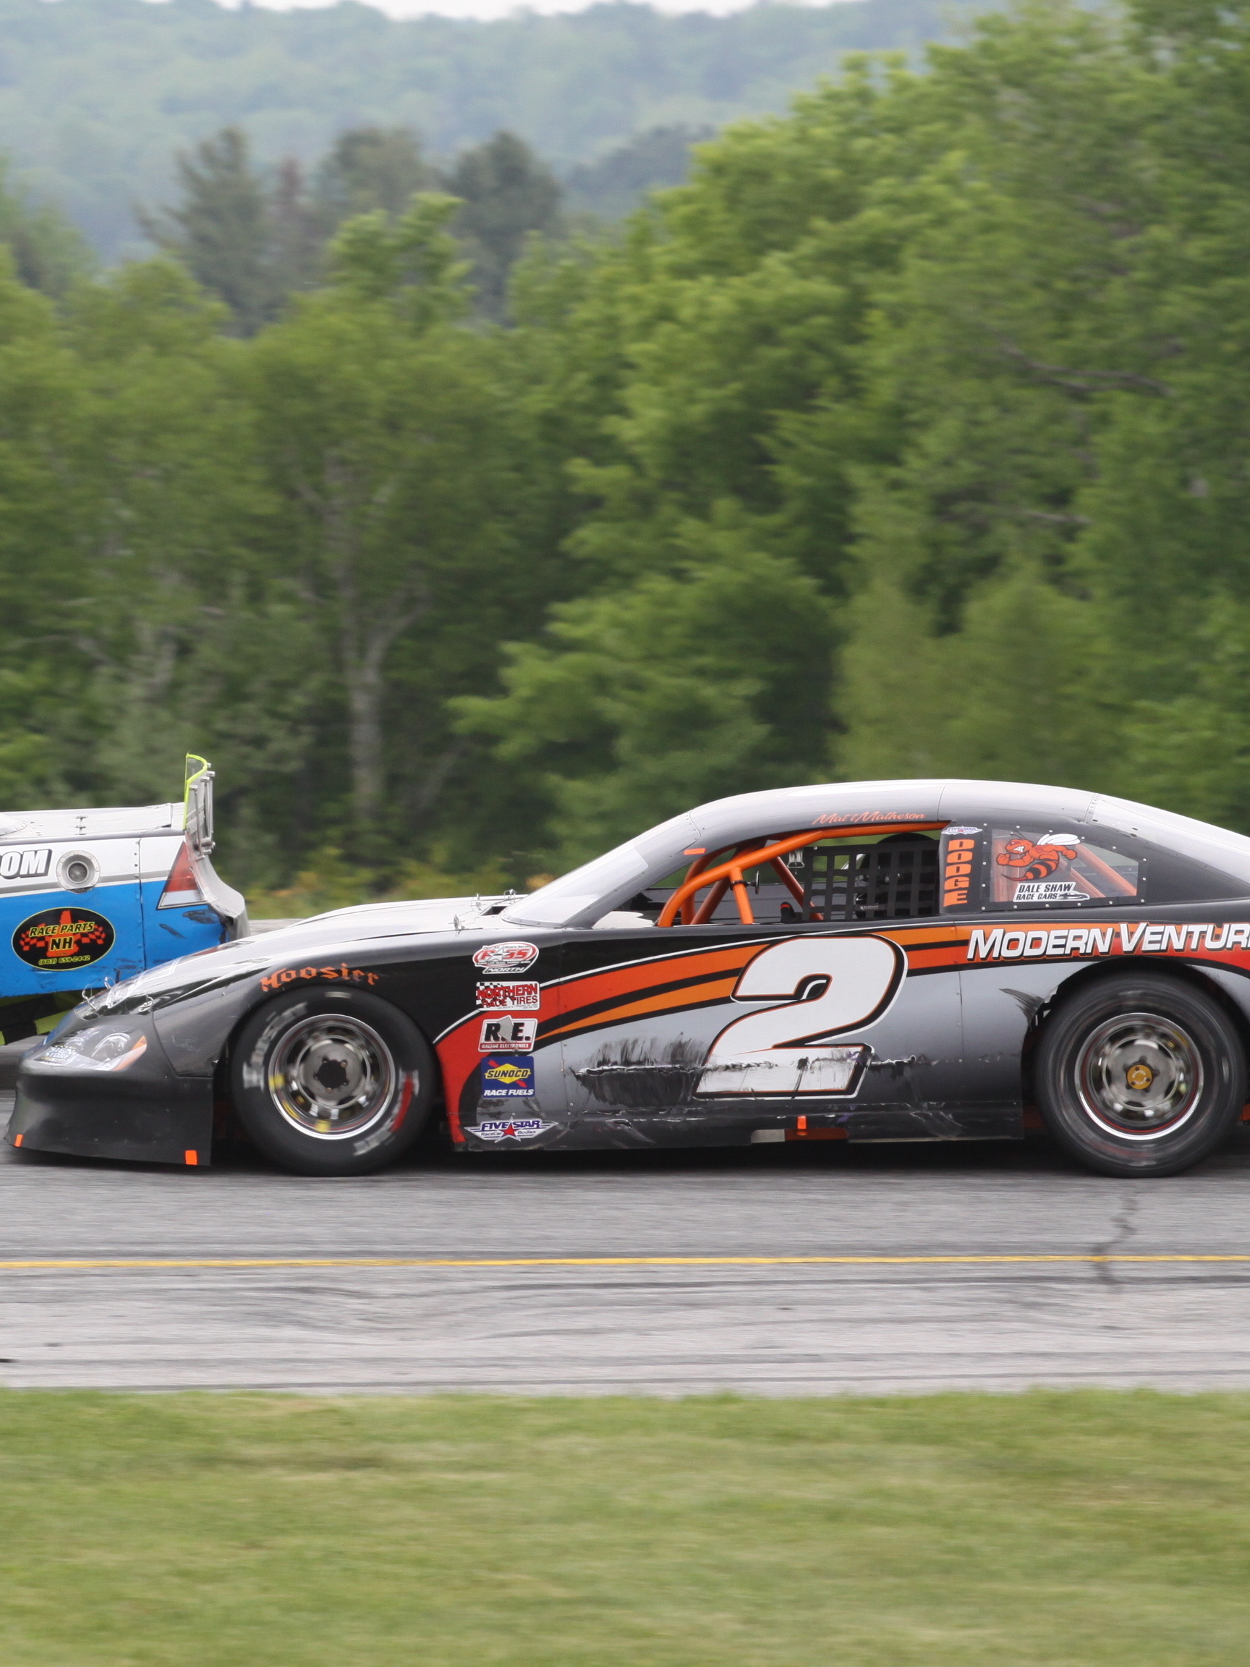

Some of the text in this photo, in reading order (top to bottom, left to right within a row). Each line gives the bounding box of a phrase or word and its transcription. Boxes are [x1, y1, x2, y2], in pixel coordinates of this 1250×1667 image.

[943, 838, 975, 907] DODGE
[1018, 883, 1073, 893] DALE SHAW
[29, 921, 95, 937] RACE PARTS
[50, 936, 74, 951] NH
[966, 927, 1114, 962] MODERN
[258, 962, 380, 991] Hoosier
[476, 983, 537, 999] NORTHERN
[482, 999, 507, 1008] RACE
[510, 995, 538, 1005] TIRES
[693, 934, 906, 1099] 2
[487, 1069, 529, 1078] SUNOCO
[508, 1088, 534, 1096] FUELS
[481, 1120, 541, 1131] FIVE STAR
